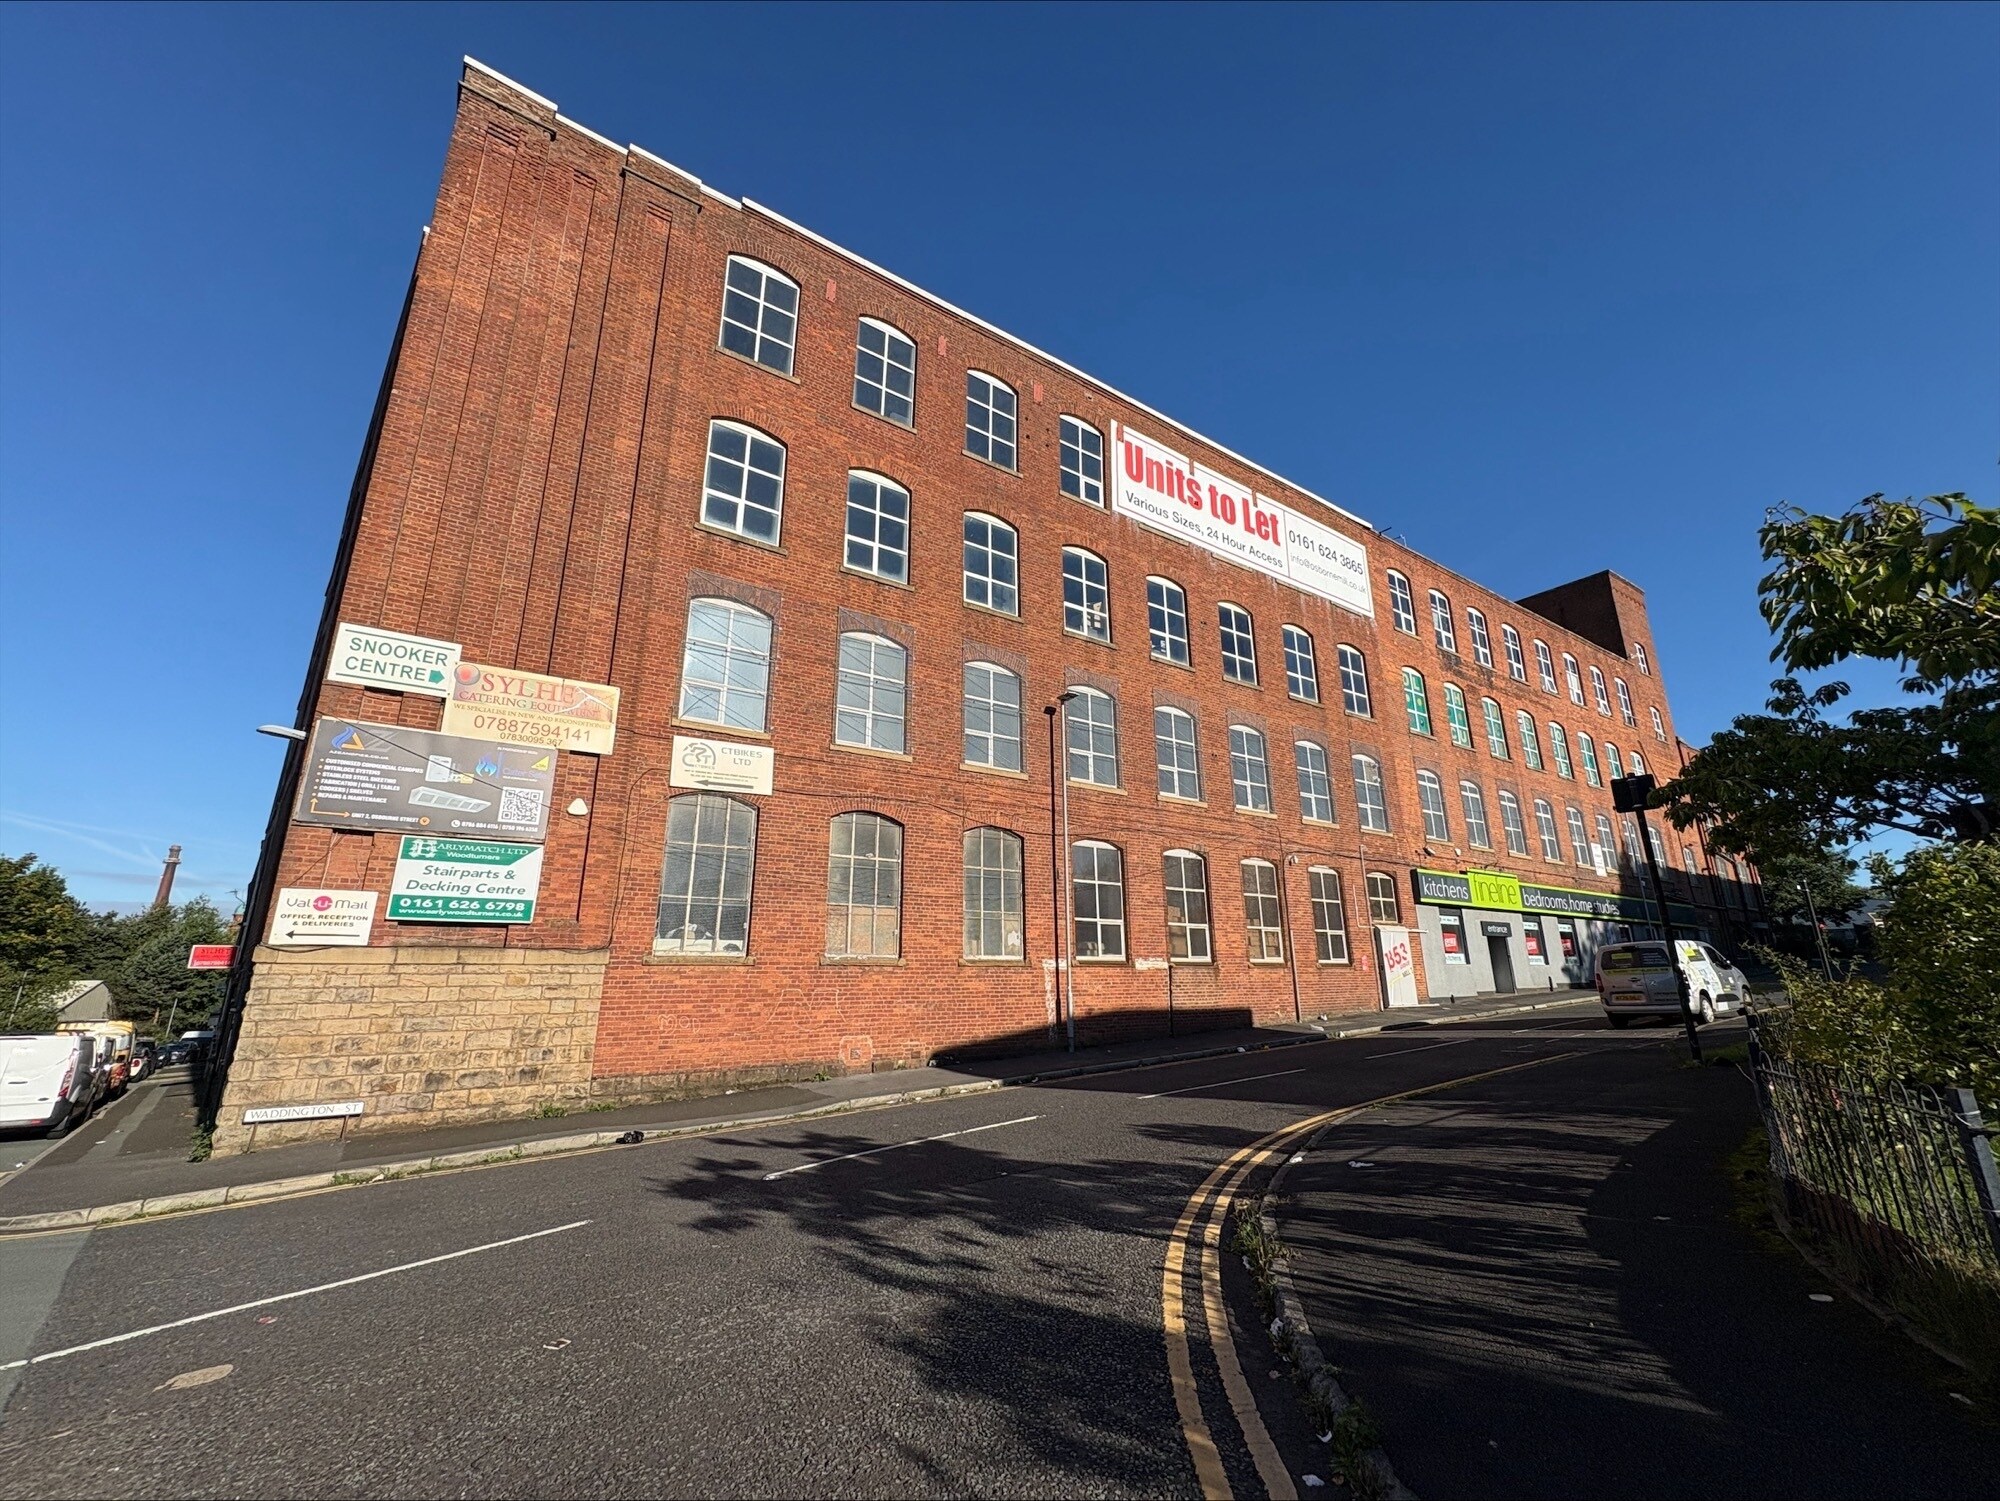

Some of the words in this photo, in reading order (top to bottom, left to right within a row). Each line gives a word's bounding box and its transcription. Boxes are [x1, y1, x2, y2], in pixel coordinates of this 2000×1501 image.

[1124, 440, 1203, 511] Units
[1208, 484, 1236, 525] to
[1242, 497, 1281, 546] Let
[1125, 490, 1169, 519] Various
[1172, 511, 1204, 536] Sizes,
[1206, 526, 1220, 541] 24
[1221, 533, 1246, 551] Hour
[1248, 545, 1283, 568] Access
[1288, 530, 1315, 552] 0161
[1318, 544, 1338, 562] 624
[1340, 554, 1364, 575] 3865
[349, 637, 448, 666] SNOOKER
[345, 656, 427, 681] CENTRE
[459, 691, 526, 708] CATERING
[467, 704, 508, 716] SPECIALISE
[519, 711, 536, 719] NEW
[538, 714, 553, 722] AND
[554, 716, 612, 730] RECONDITIONED
[474, 715, 591, 743] 07887594141
[500, 733, 544, 744] 07830095
[721, 747, 762, 758] CTBIKES
[325, 758, 361, 767] CUSTOMISED
[361, 762, 397, 771] COMMERCIAL
[733, 758, 751, 766] LTD
[322, 772, 352, 780] STAINLESS
[353, 774, 369, 782] STEEL
[323, 765, 355, 773] INTERLOCK
[356, 768, 381, 776] SYSTEMS
[319, 785, 346, 793] COOKERS
[320, 779, 358, 787] FABRICATION
[317, 792, 342, 800] REPAIRS
[400, 815, 419, 823] STREET
[446, 851, 500, 861] Woodturners
[506, 847, 529, 856] LTD
[422, 865, 499, 880] Stairparts
[504, 870, 516, 879] &
[405, 880, 471, 895] Decking
[476, 883, 526, 895] Centre
[1422, 876, 1469, 900] kitchens
[400, 898, 443, 909] 0161
[449, 899, 480, 909] 626
[485, 900, 525, 911] 6798
[1593, 899, 1620, 915] studies
[398, 908, 523, 917] www.earlywoodturners.co.uk
[1487, 925, 1507, 933] entrance
[251, 1106, 334, 1119] WADDINGTON
[345, 1104, 359, 1113] ST
